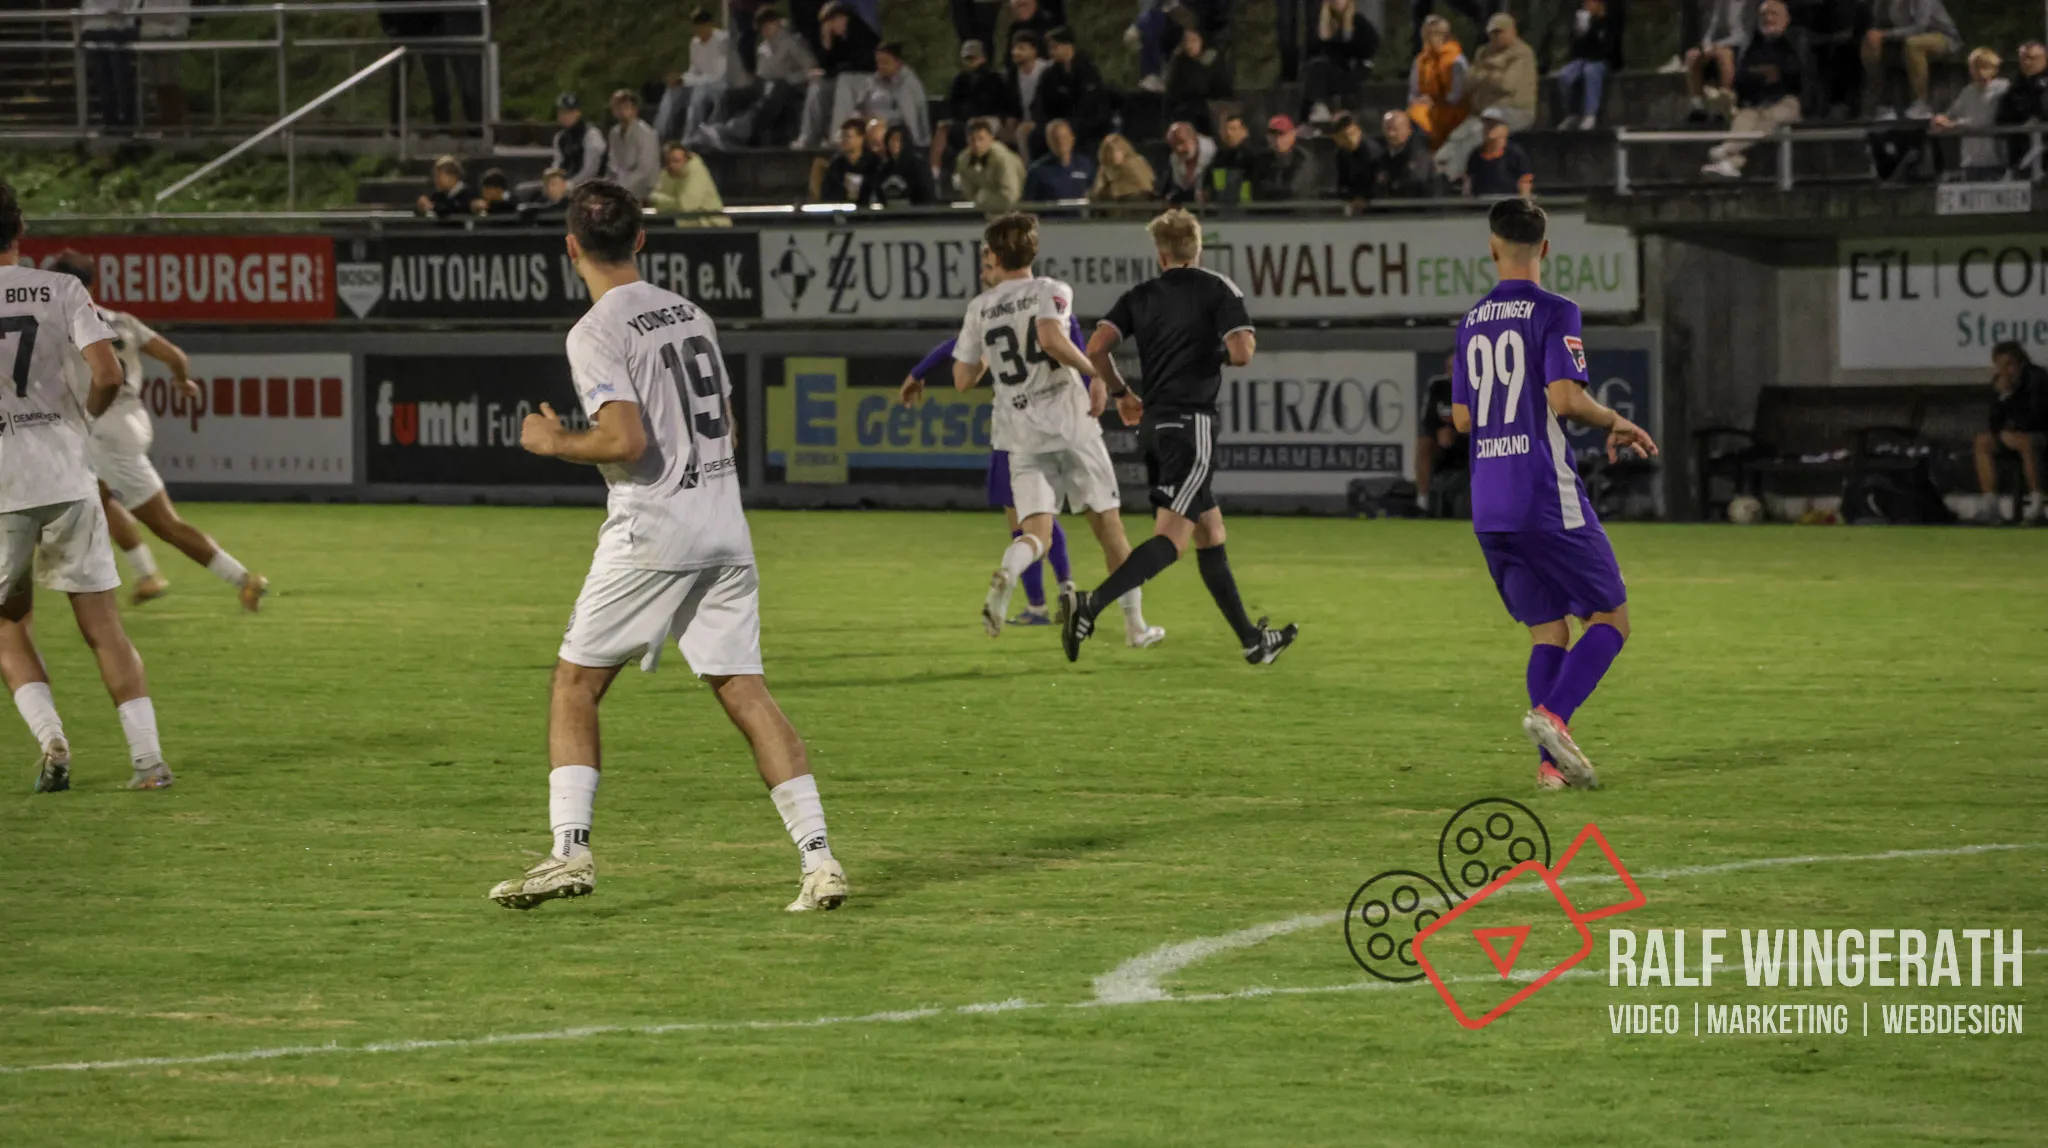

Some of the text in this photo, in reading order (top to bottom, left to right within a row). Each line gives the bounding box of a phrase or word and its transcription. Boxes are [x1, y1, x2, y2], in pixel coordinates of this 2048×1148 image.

[6, 287, 50, 303] BOYS
[100, 253, 313, 303] REIBURGER
[389, 254, 549, 302] AUTOHAUS
[697, 252, 753, 301] e.K.
[1245, 242, 1622, 297] WALCH FENSRBAU
[1850, 245, 2048, 301] ETL CO
[1465, 301, 1536, 328] FC NÖTTINGEN
[984, 315, 1061, 386] 34
[1466, 329, 1526, 428] 99
[141, 377, 207, 434] roup
[376, 381, 478, 446] fuma
[660, 335, 730, 440] 19
